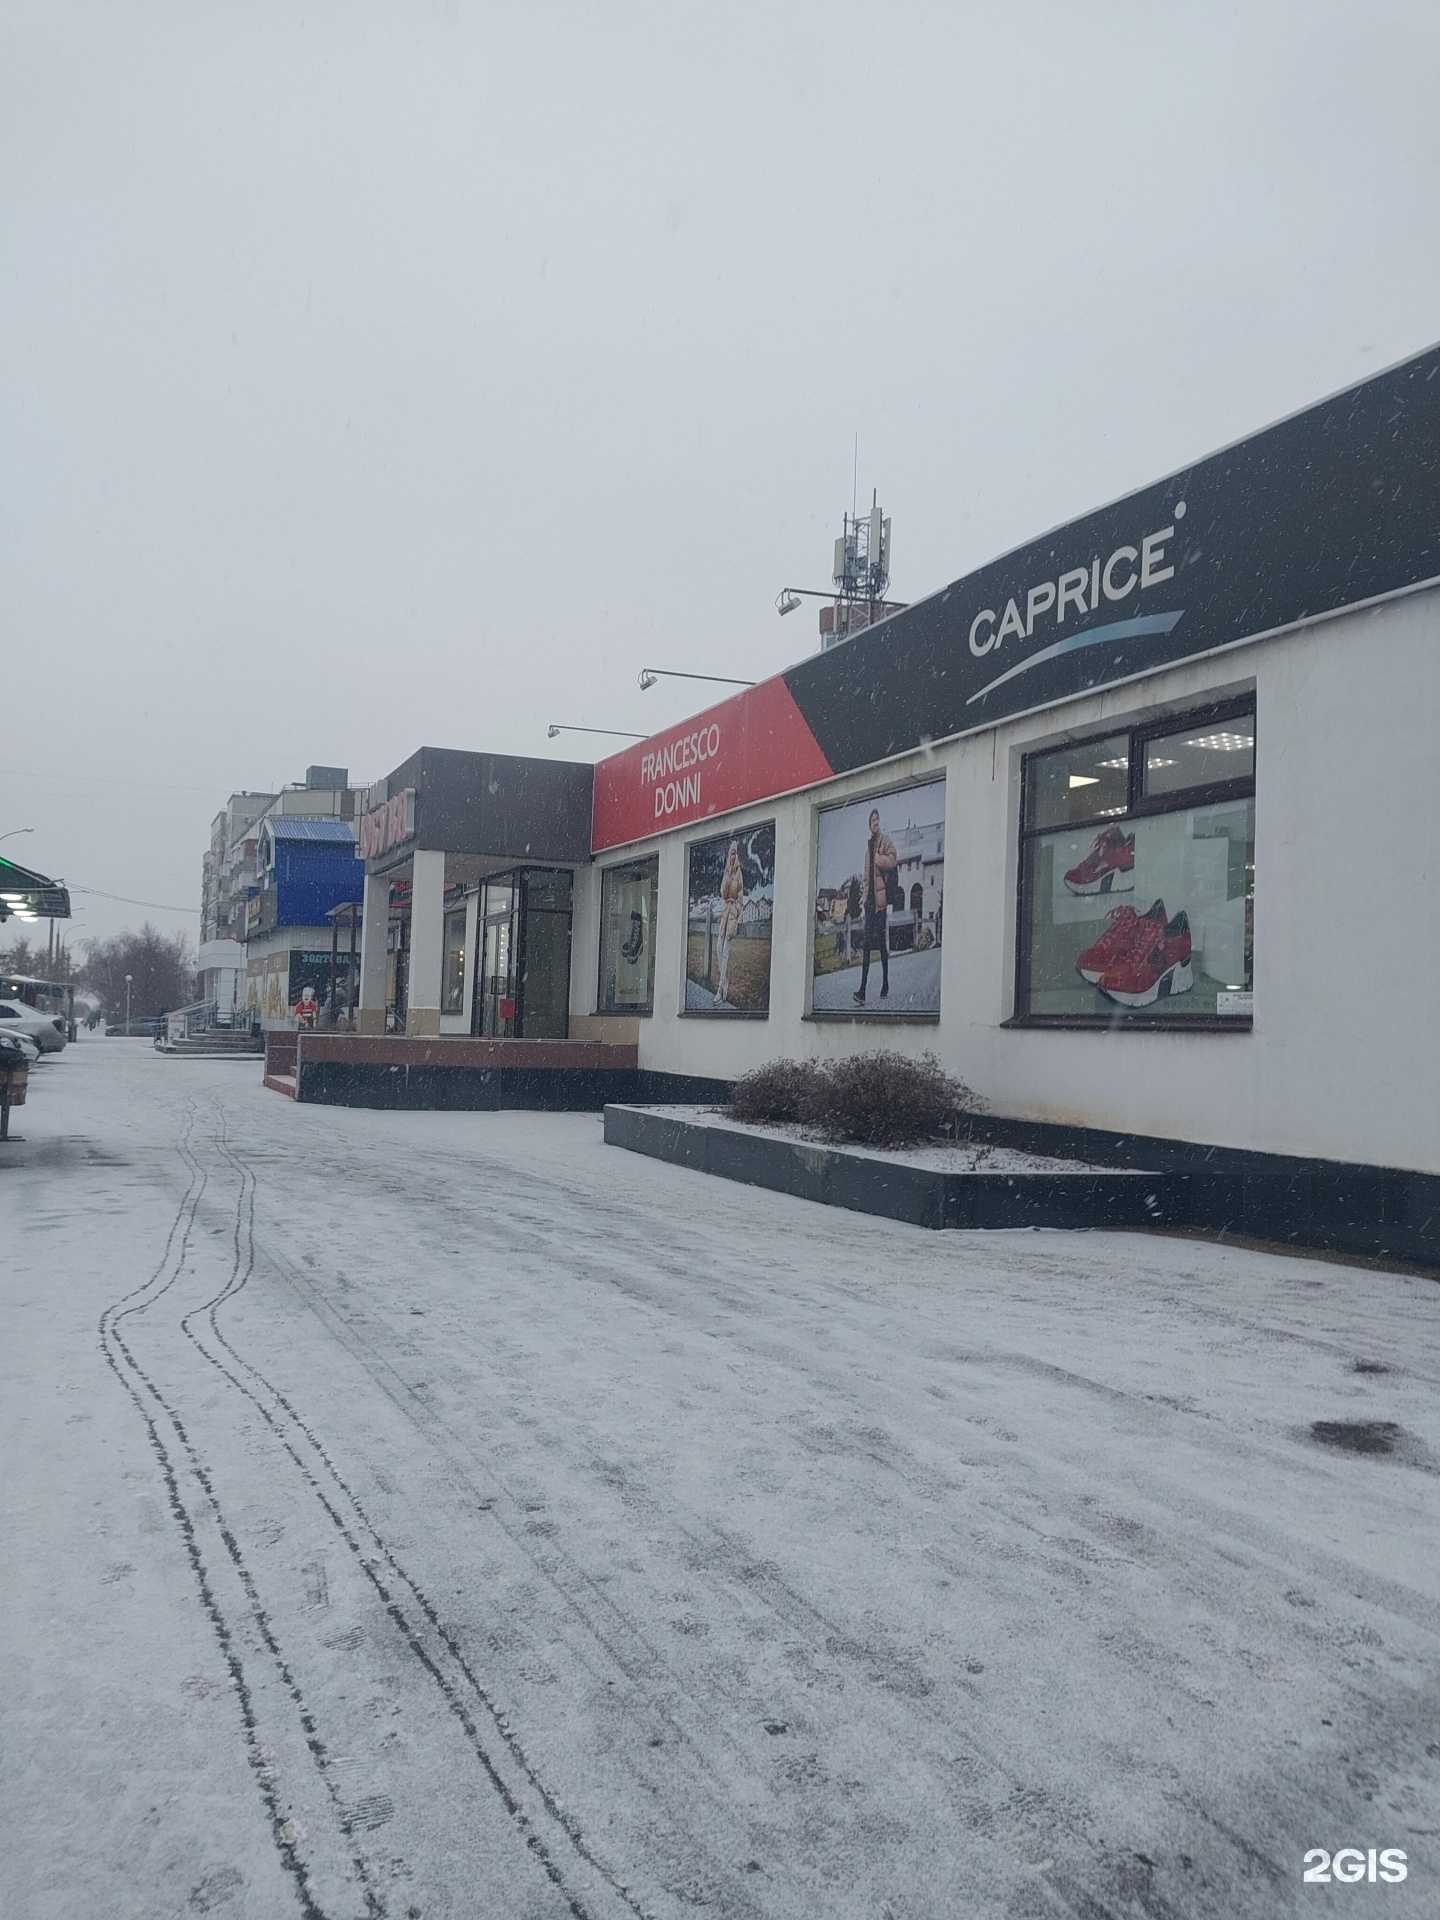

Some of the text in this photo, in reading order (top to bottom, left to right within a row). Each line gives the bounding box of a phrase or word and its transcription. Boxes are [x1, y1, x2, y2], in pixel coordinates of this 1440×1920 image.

[968, 525, 1175, 657] CAPRICE
[641, 723, 720, 785] FRANCESCO
[654, 772, 701, 818] DONNI
